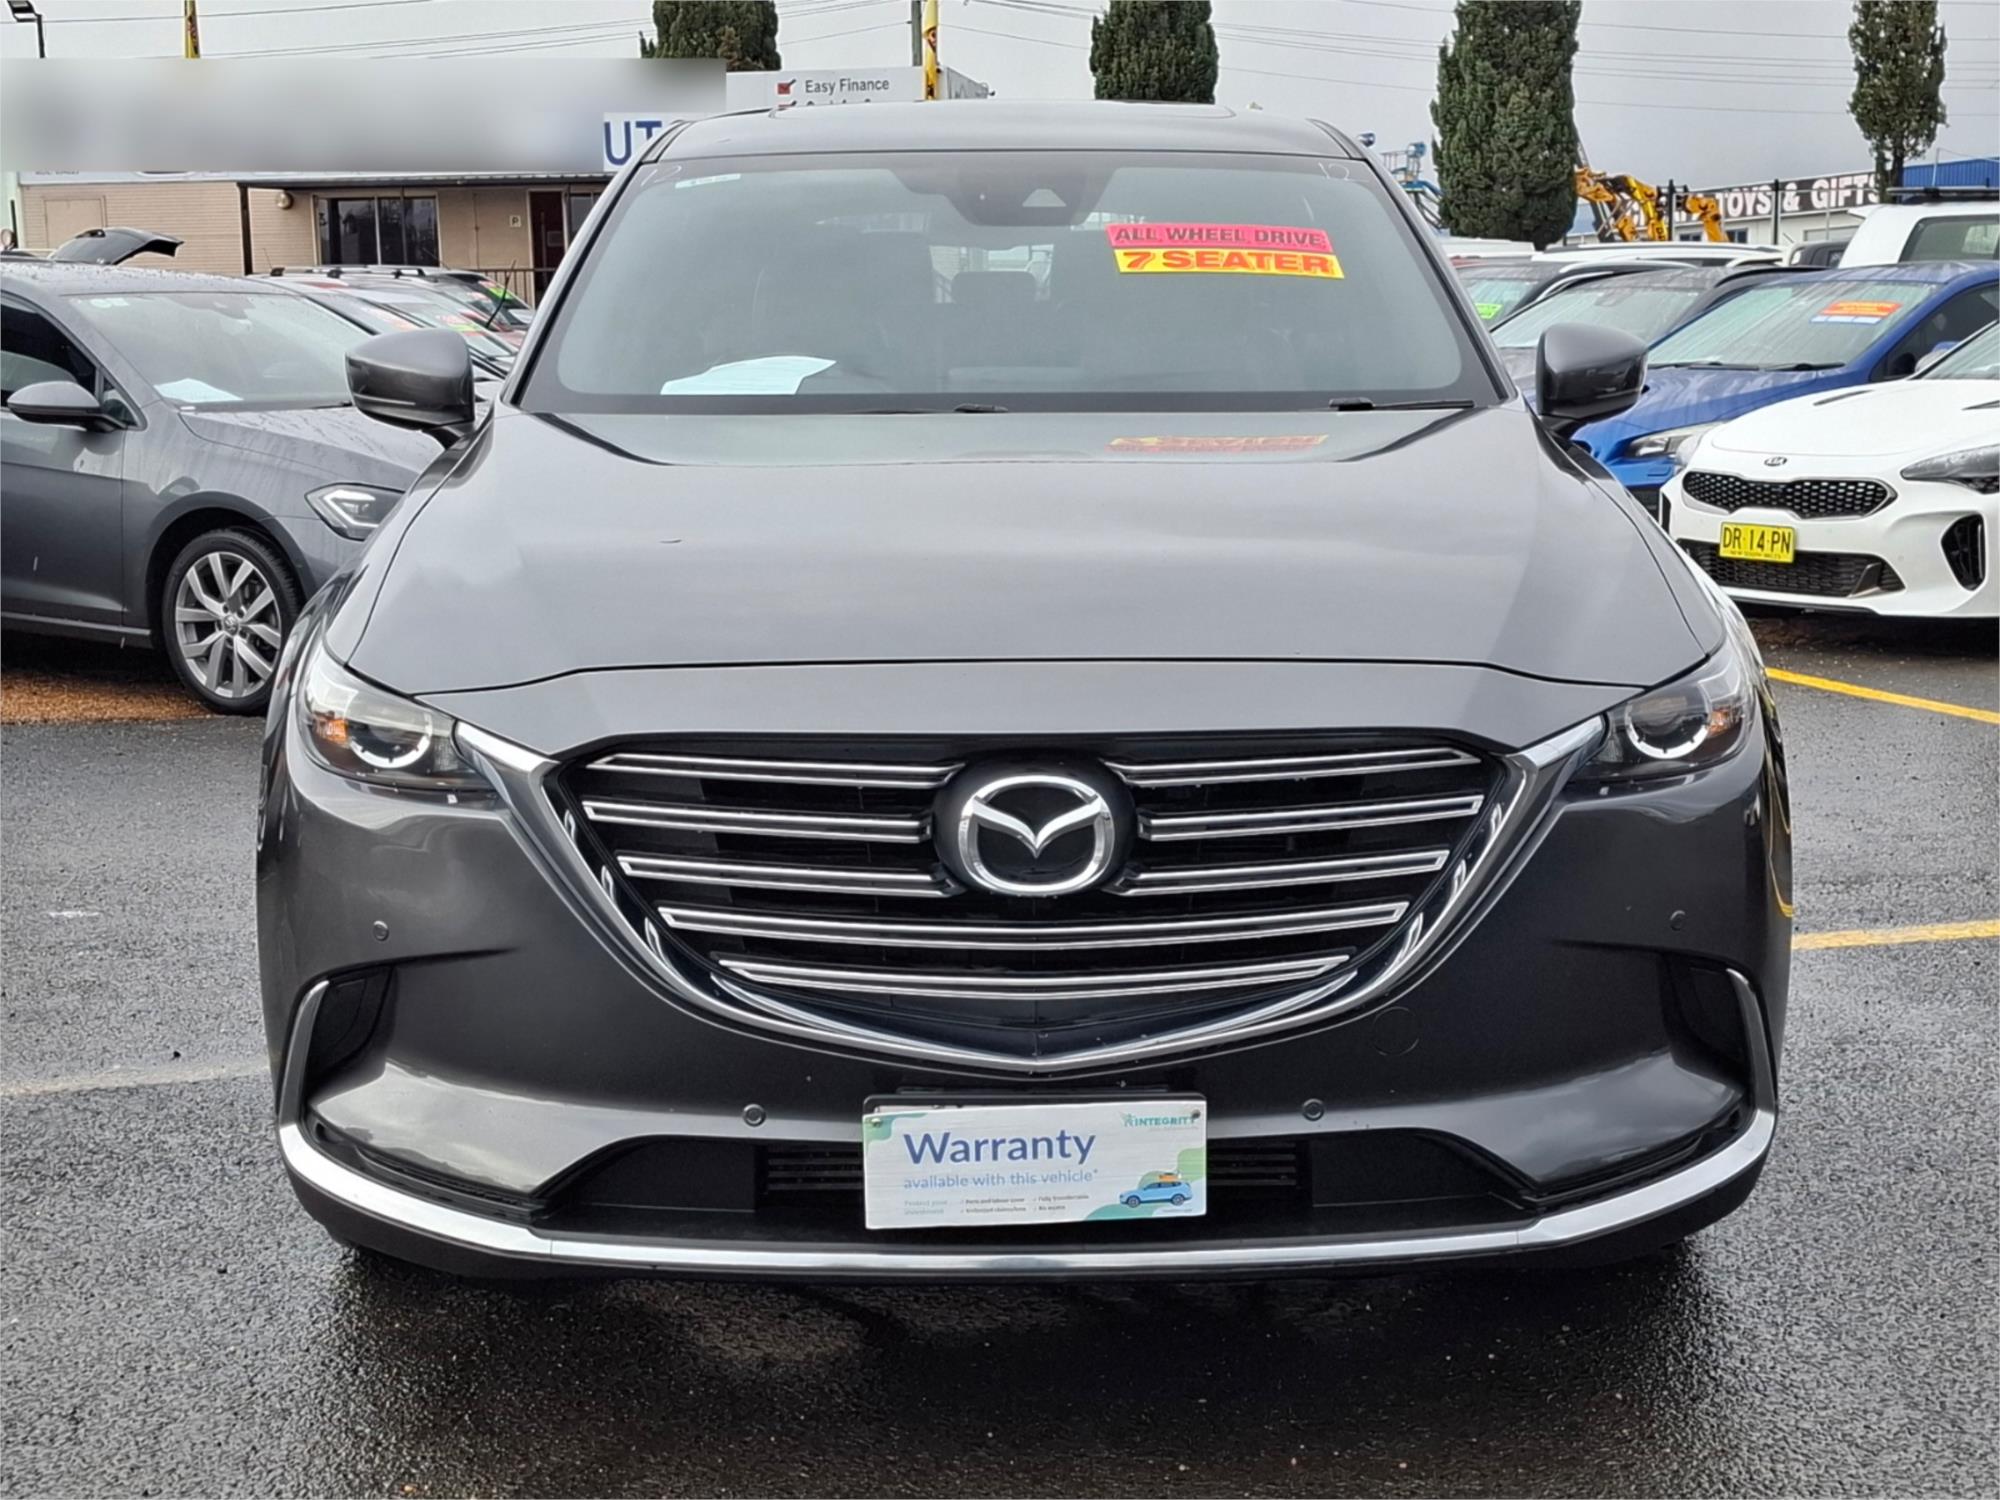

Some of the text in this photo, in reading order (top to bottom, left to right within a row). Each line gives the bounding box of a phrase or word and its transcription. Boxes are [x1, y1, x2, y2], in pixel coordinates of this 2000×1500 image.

[805, 78, 890, 95] Easy Finance
[1716, 187, 1773, 218] TOYS
[1783, 183, 1800, 211] &
[1811, 173, 1881, 210] GIFTS
[1115, 227, 1325, 246] ALL WHEEL DRIVE
[1123, 250, 1336, 274] 7 SEATER
[903, 1129, 1096, 1165] Warranty
[903, 1174, 969, 1189] available
[972, 1172, 1006, 1187] with
[1010, 1171, 1037, 1186] this
